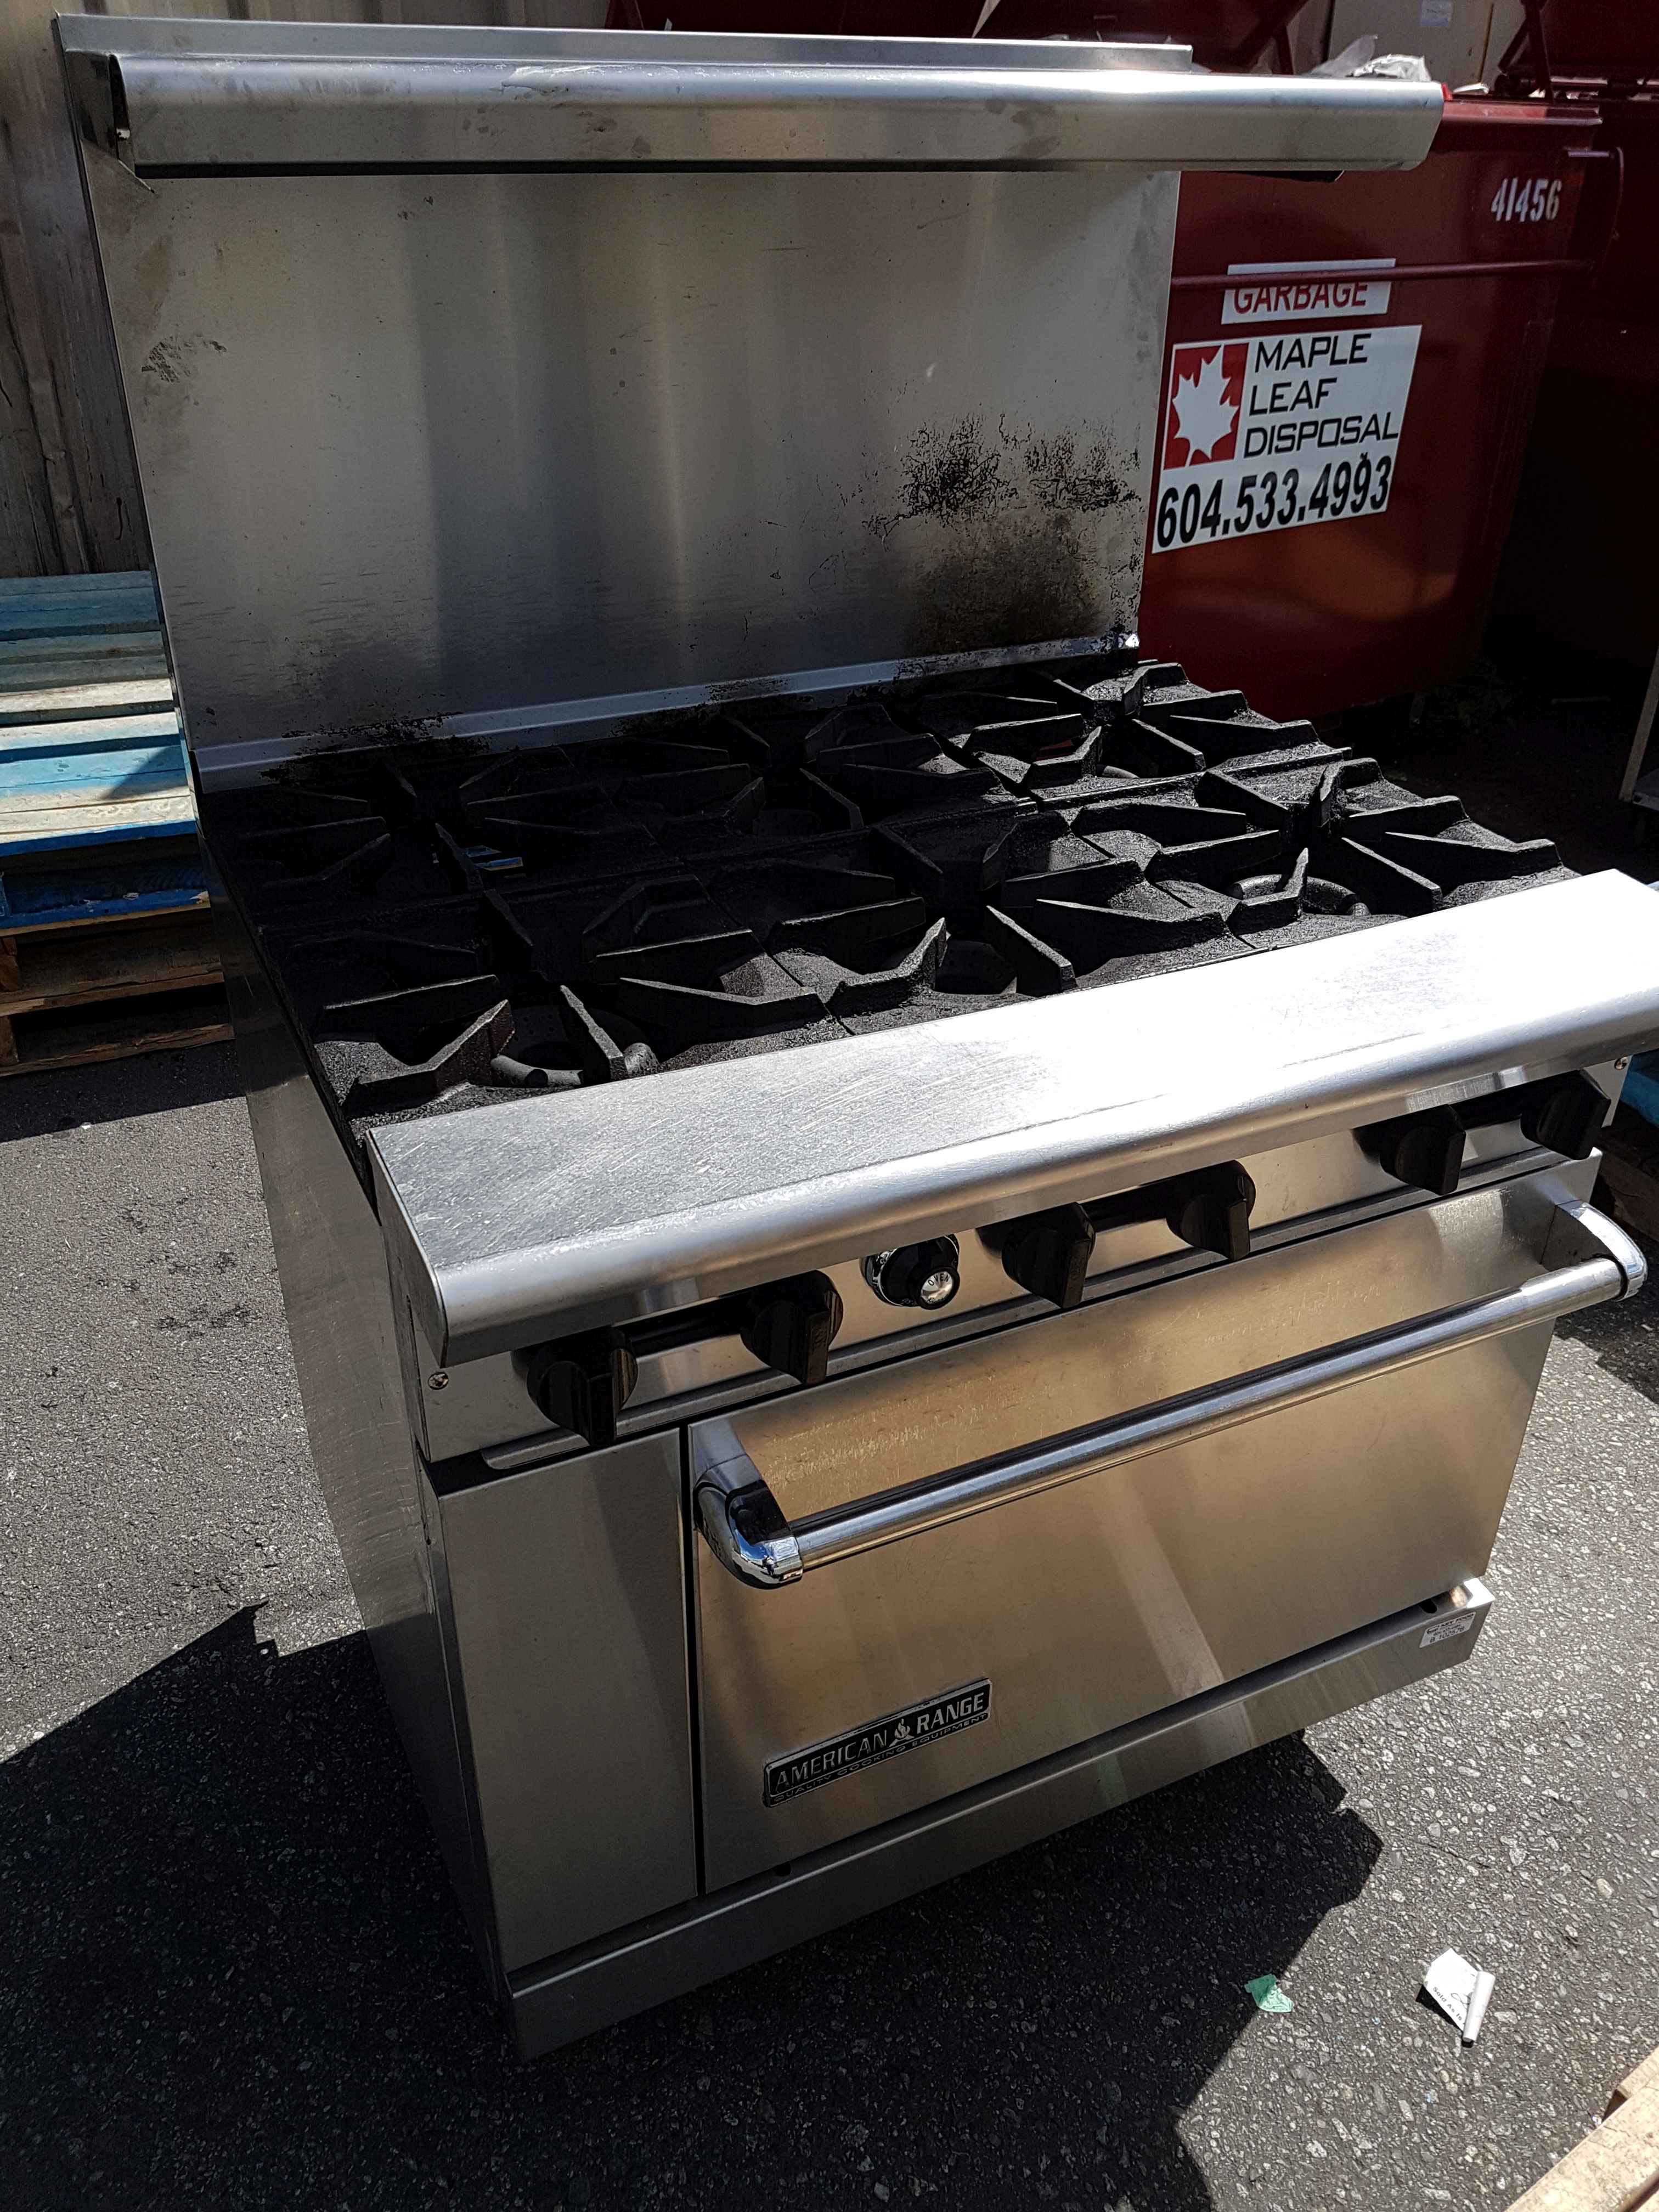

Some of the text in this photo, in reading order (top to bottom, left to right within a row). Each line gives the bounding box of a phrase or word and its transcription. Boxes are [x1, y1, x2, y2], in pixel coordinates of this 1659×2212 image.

[1491, 177, 1562, 222] 41456
[1234, 283, 1368, 314] GARBAGE
[1255, 333, 1372, 373] MAPLE
[1249, 377, 1338, 416] LEAF
[1243, 412, 1399, 459] DISPOSAL
[1157, 455, 1392, 548] 604.533.4993
[928, 1273, 950, 1286] OVEN
[774, 1713, 987, 1802] QUALITY COOKING EQUIPMENT
[775, 1692, 984, 1793] AMERICAN RANGE
[1433, 1987, 1447, 2002] Sold
